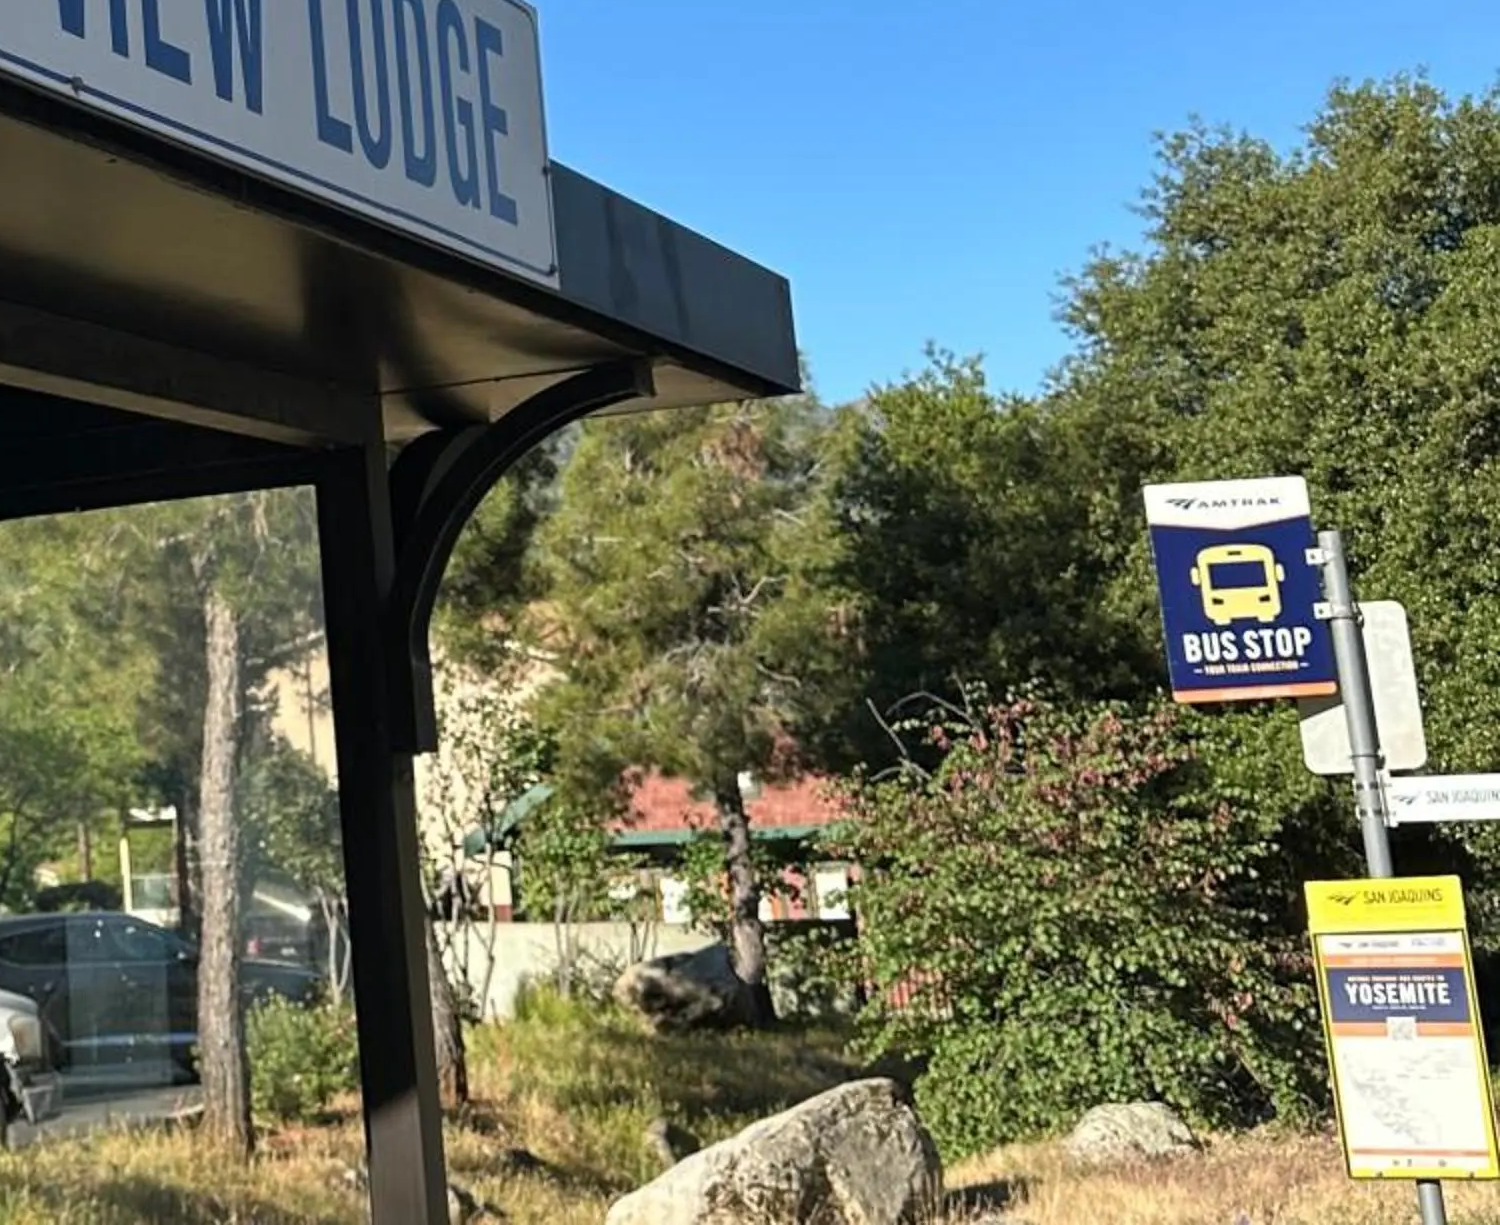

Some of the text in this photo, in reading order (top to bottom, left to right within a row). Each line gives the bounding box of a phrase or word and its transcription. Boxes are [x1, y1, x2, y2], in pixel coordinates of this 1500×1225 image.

[1197, 496, 1281, 509] AMTRAK
[1183, 626, 1312, 663] BUS STOP
[1425, 788, 1449, 805] SAN
[1362, 887, 1444, 905] SAN JOAQUINS
[1344, 981, 1452, 1006] YOSEMITE
